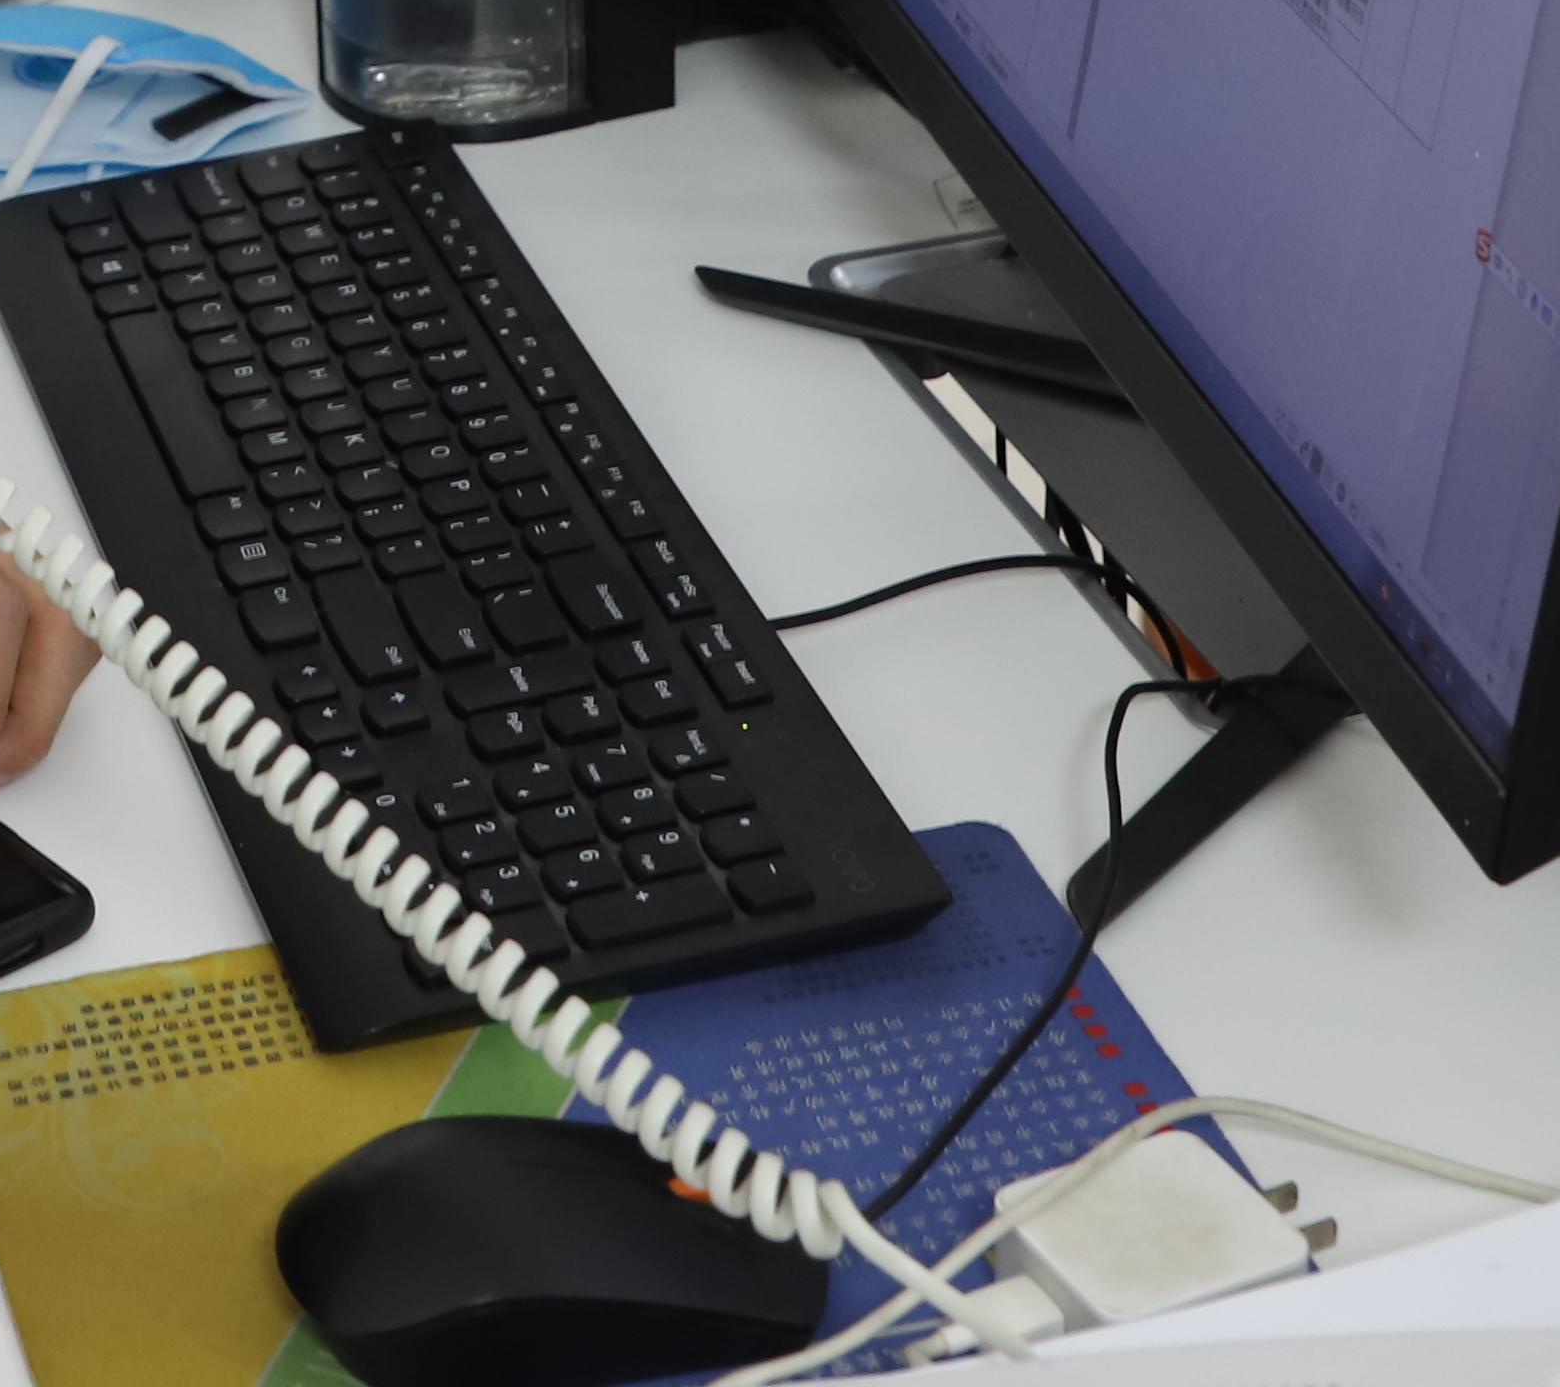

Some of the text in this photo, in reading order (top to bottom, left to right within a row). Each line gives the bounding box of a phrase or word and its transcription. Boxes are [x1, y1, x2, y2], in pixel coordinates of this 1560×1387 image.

[305, 225, 323, 239] W
[358, 231, 374, 240] 3
[171, 244, 189, 253] Z
[242, 245, 260, 255] S
[320, 255, 338, 265] E
[187, 273, 204, 283] X
[258, 275, 276, 285] D
[338, 285, 356, 295] R
[393, 291, 409, 300] 5
[203, 303, 220, 313] C
[274, 305, 292, 313] F
[357, 315, 374, 325] T
[412, 321, 428, 331] 6
[220, 334, 237, 344] V
[291, 337, 310, 348] G
[374, 346, 392, 355] Y
[429, 353, 446, 361] 7
[235, 366, 253, 377] B
[309, 368, 328, 379] H
[392, 378, 412, 389] U
[451, 386, 468, 394] 8
[328, 403, 346, 411] J
[469, 419, 486, 427] 9
[268, 431, 288, 445] M
[345, 434, 364, 446] K
[363, 468, 380, 479] L
[450, 480, 470, 491] P
[607, 744, 626, 755] 7
[532, 763, 550, 773] 4
[452, 778, 470, 787] 1
[634, 788, 653, 799] 8
[555, 805, 575, 817] 5
[475, 821, 495, 834] 2
[659, 832, 679, 843] 9
[580, 850, 599, 861] 6
[499, 866, 519, 879] 3
